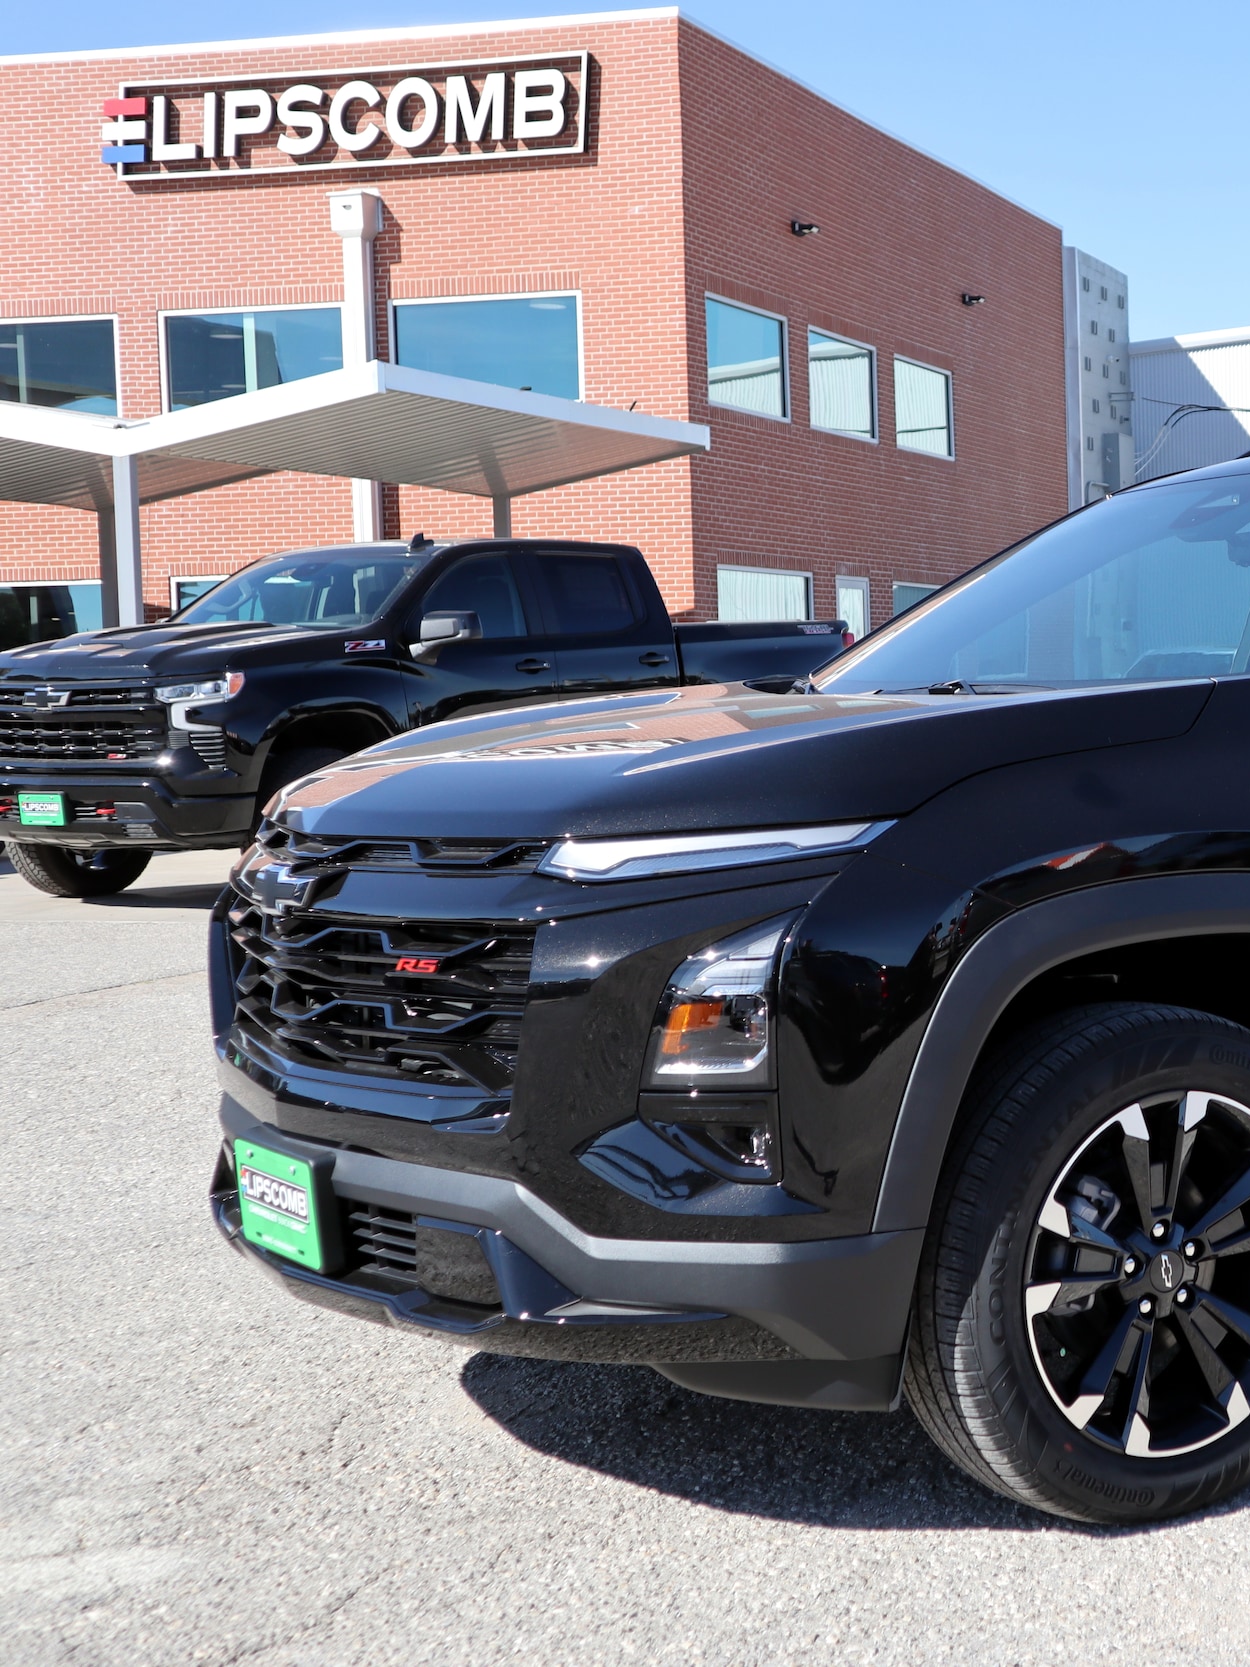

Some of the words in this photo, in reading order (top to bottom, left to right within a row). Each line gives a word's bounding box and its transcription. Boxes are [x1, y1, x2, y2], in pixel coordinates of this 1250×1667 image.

[152, 68, 567, 161] LIPSCOMB
[345, 640, 386, 653] Z71
[395, 957, 439, 973] RS
[245, 1171, 307, 1217] LIPSCOMB
